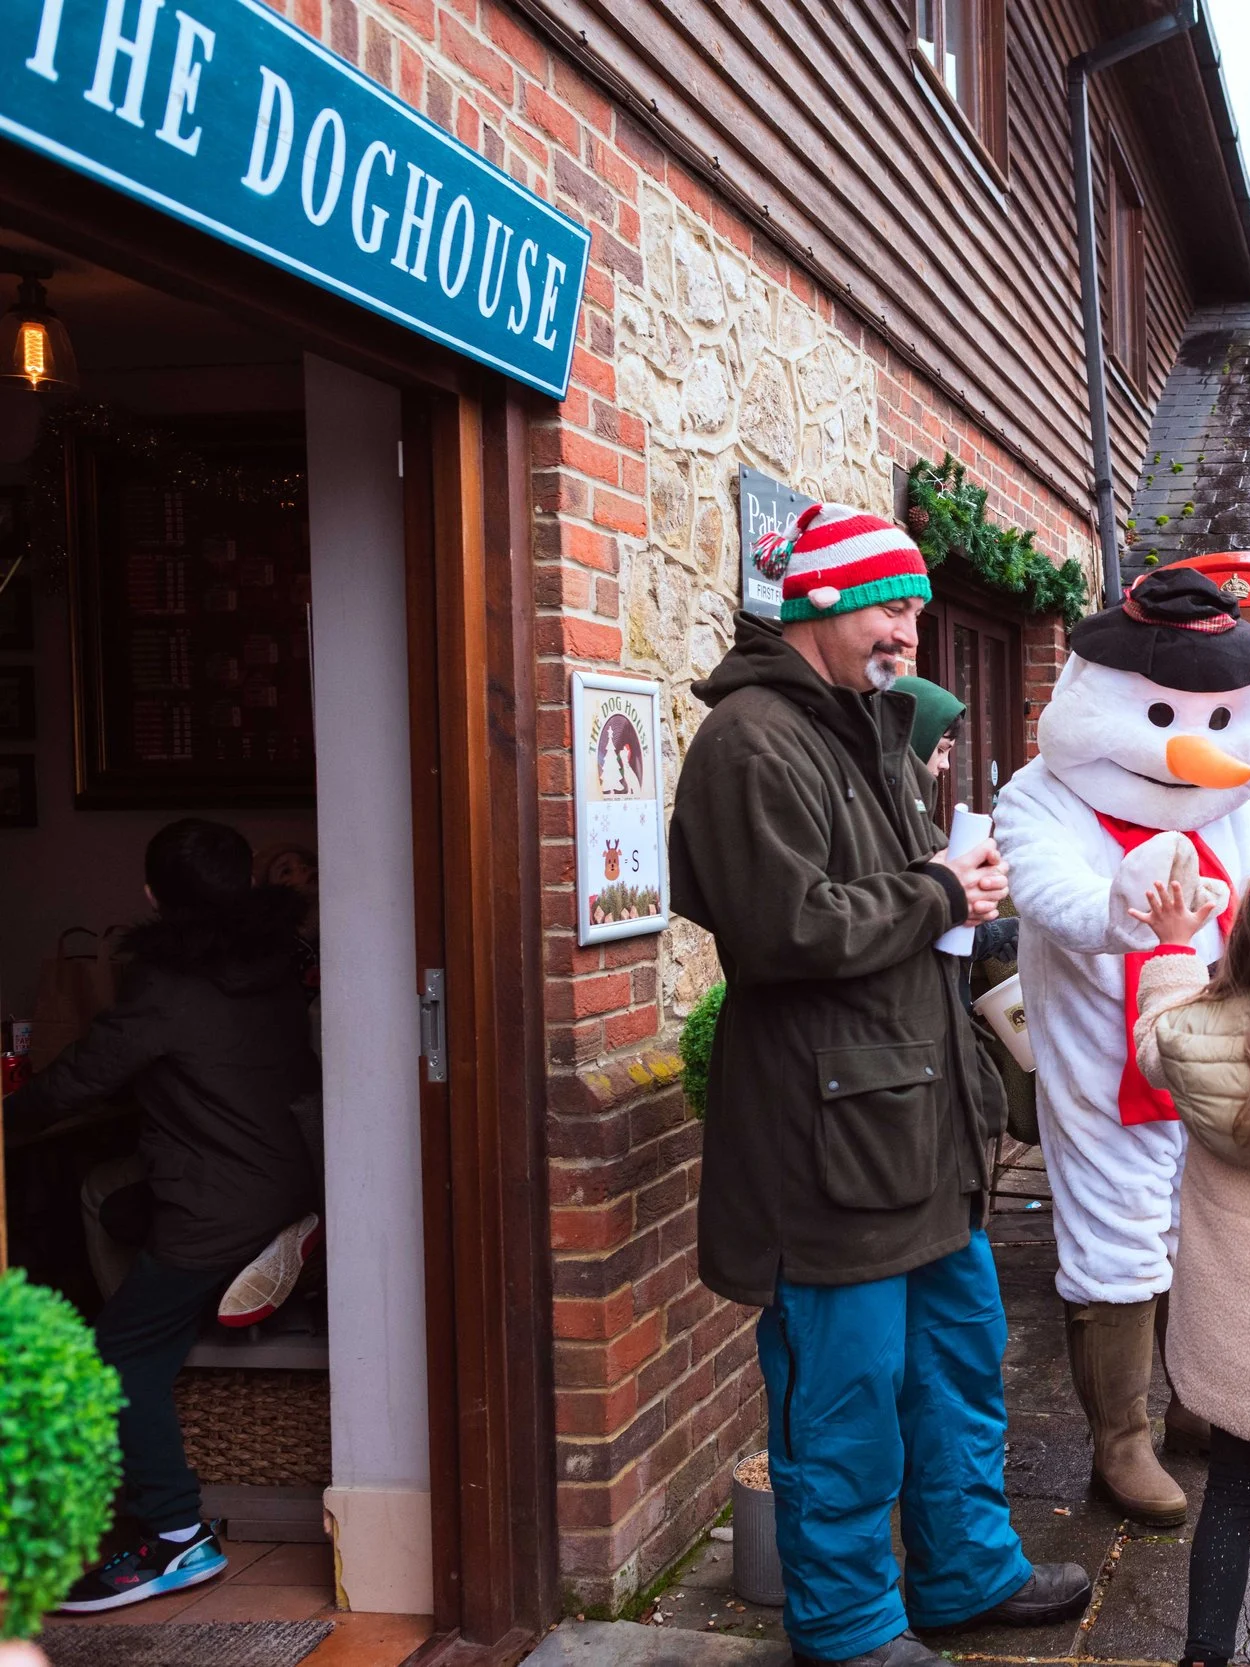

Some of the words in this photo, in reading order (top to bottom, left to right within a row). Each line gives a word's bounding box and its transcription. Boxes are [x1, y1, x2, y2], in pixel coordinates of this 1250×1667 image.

[241, 65, 567, 352] DOGHOUSE
[747, 492, 782, 536] Park
[757, 583, 775, 601] FIRST
[589, 714, 602, 754] THE
[601, 696, 622, 718] DOG
[625, 700, 649, 756] HOUSE
[631, 849, 640, 873] S
